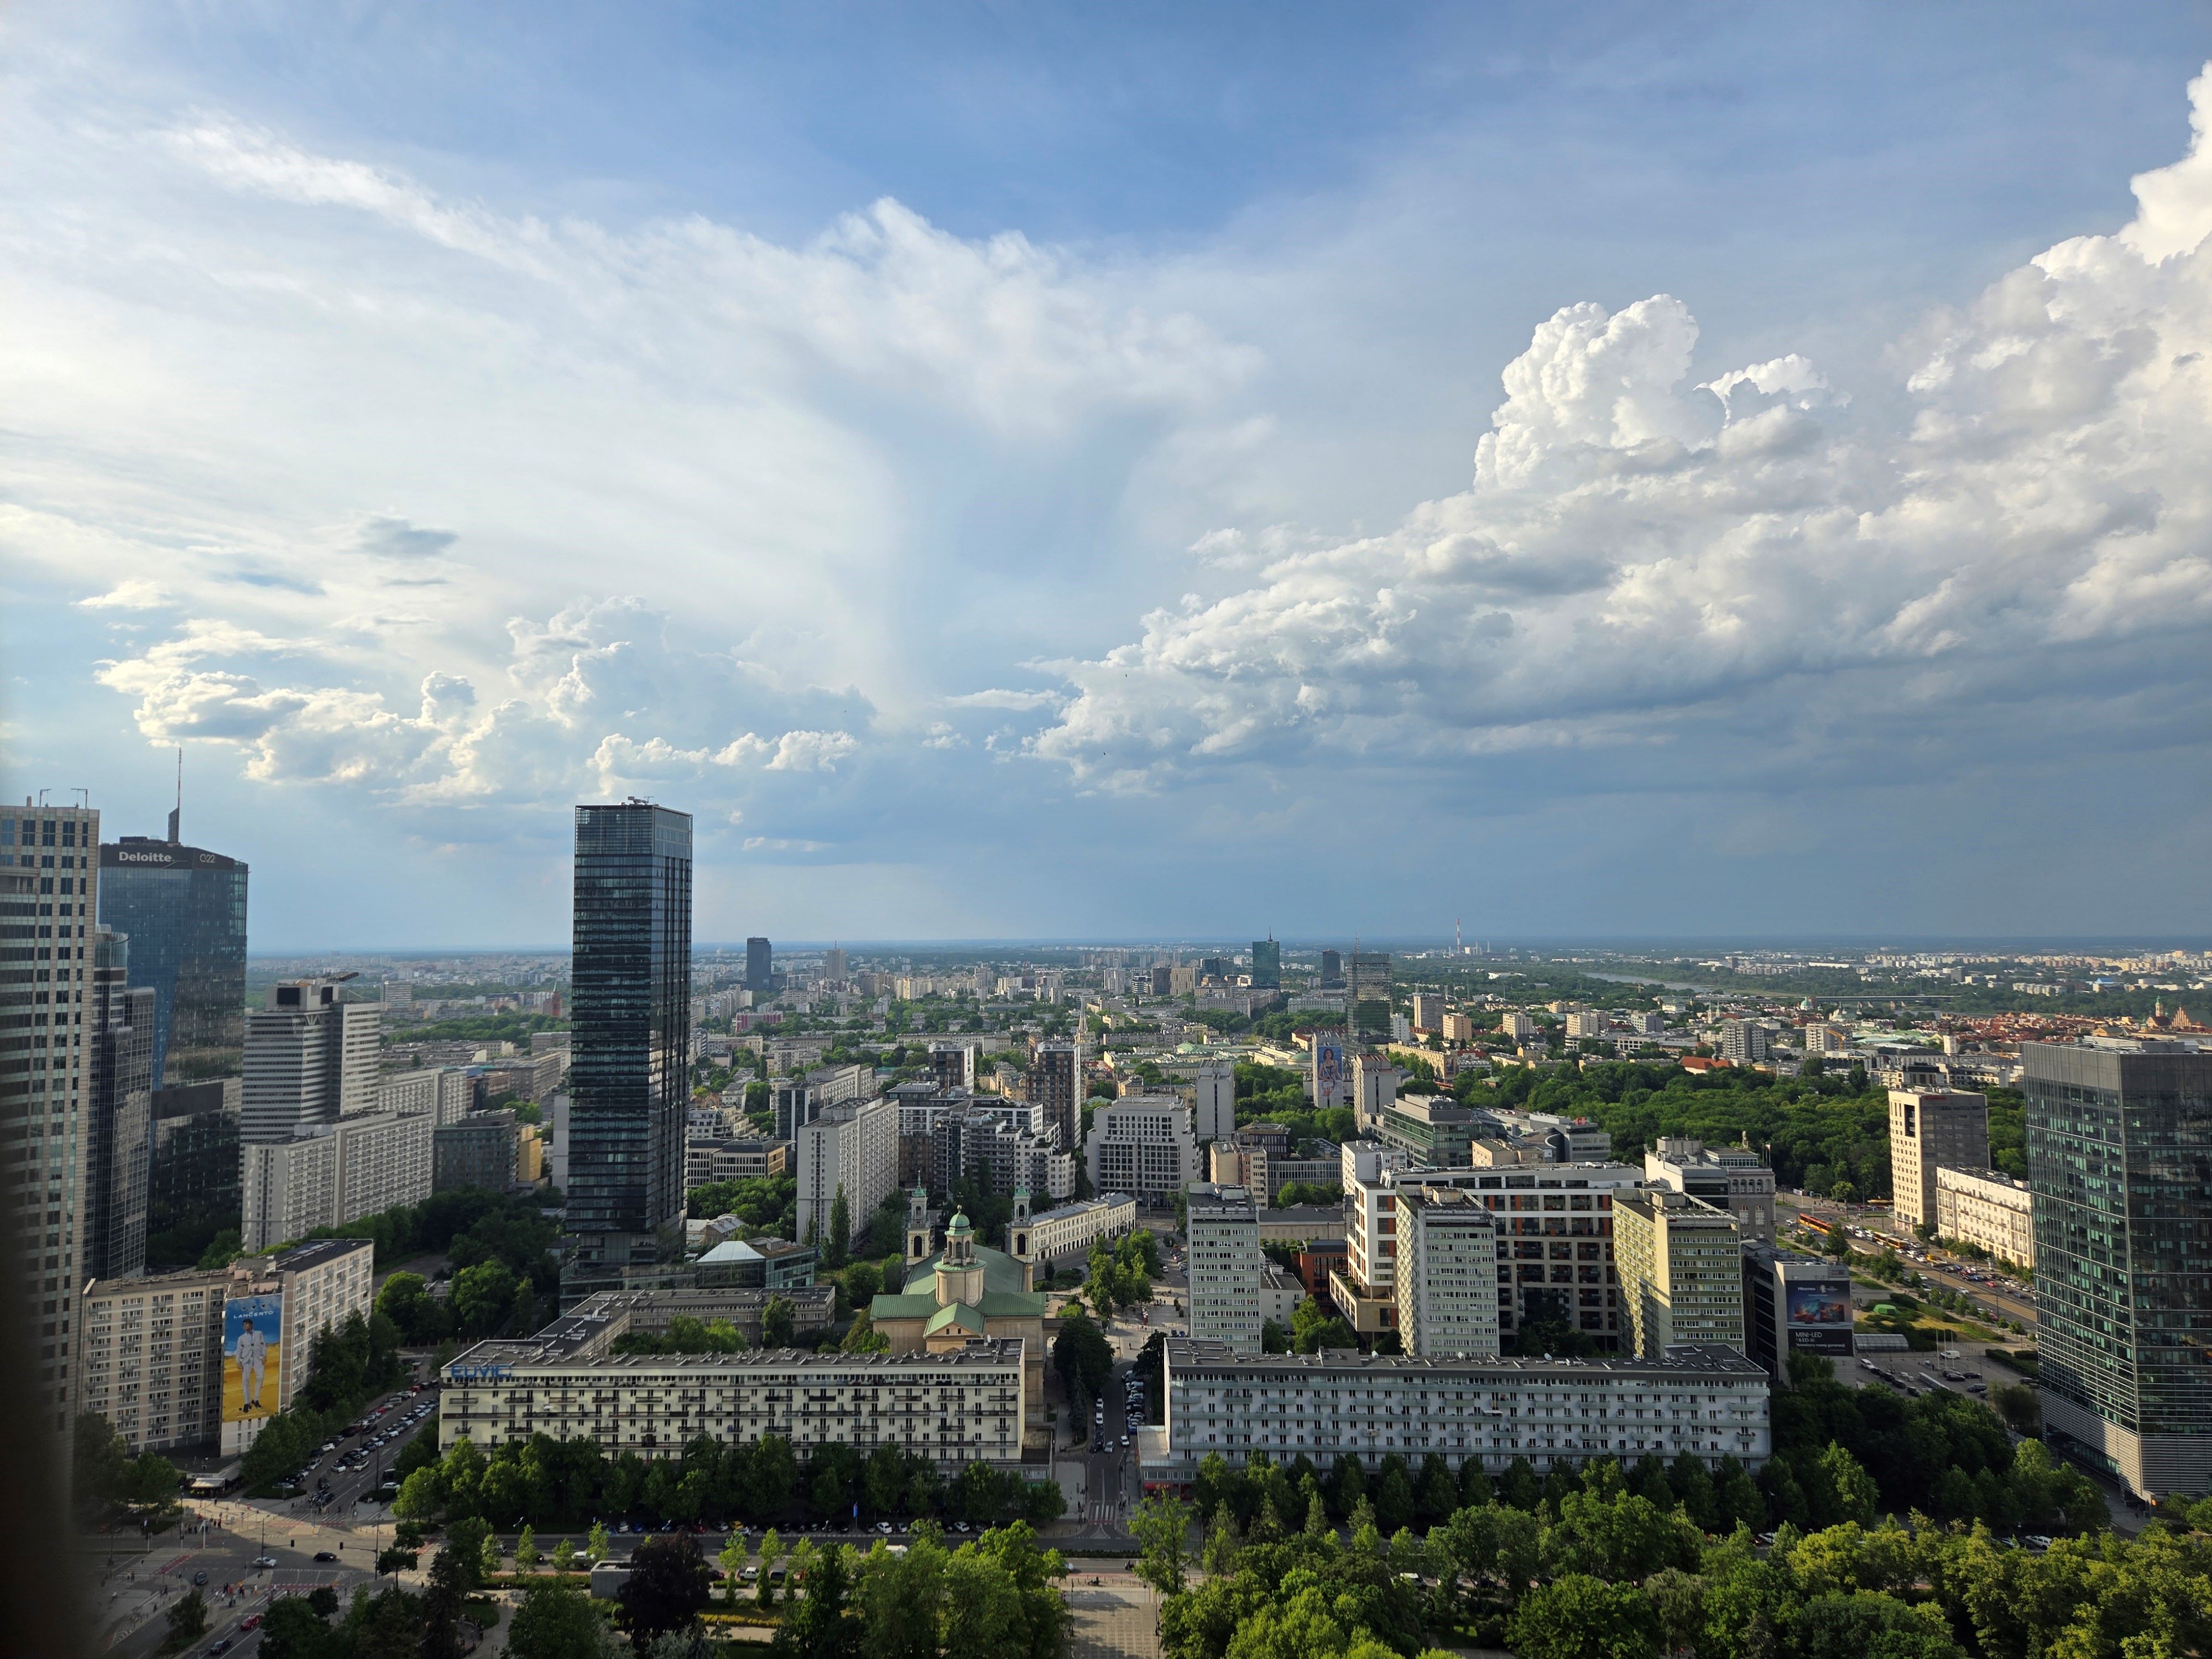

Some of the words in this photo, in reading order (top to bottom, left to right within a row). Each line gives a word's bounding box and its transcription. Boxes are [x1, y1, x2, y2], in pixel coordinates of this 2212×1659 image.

[119, 852, 171, 862] Deloitte
[200, 854, 215, 863] Q22
[233, 1310, 274, 1319] LANCERTO
